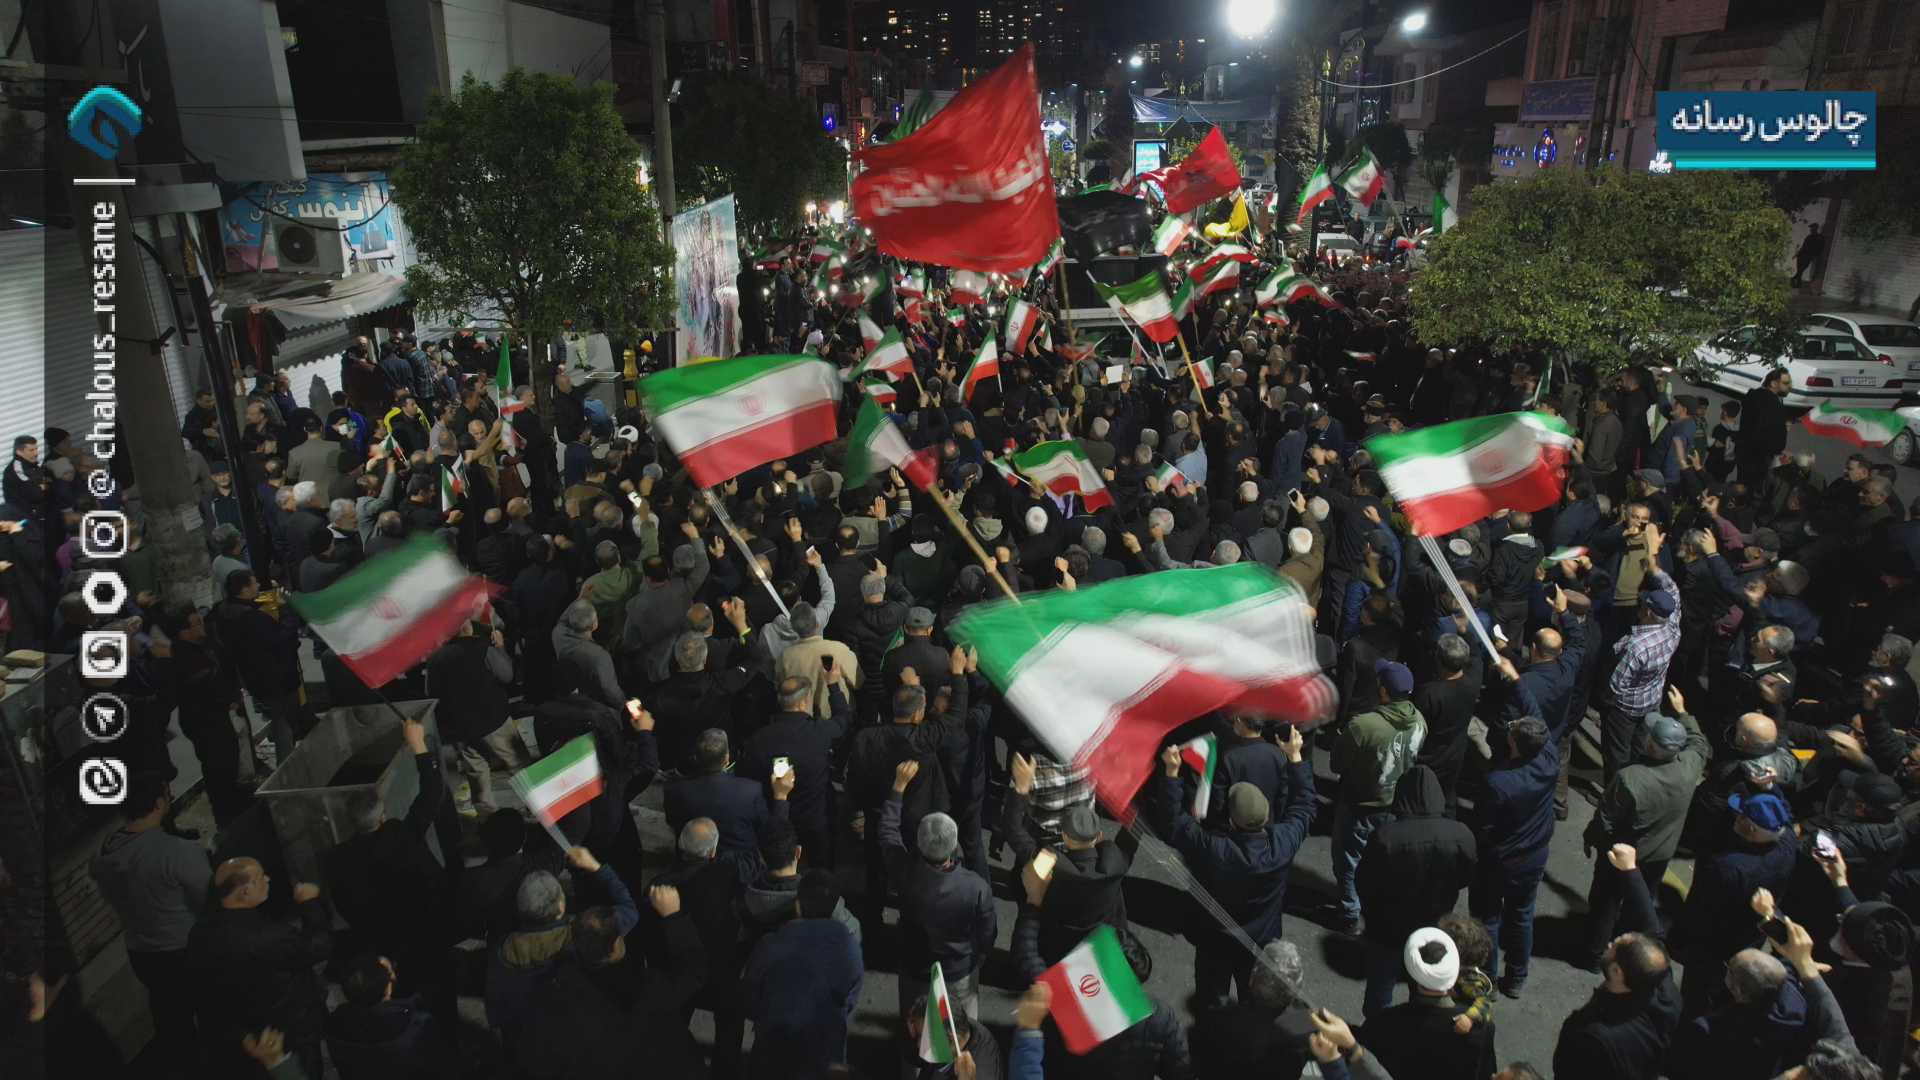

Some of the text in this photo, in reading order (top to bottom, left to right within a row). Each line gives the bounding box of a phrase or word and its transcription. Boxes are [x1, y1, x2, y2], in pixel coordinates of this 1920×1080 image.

[276, 178, 309, 197] کیف
[250, 199, 290, 222] کفش
[287, 182, 373, 225] آبنوس
